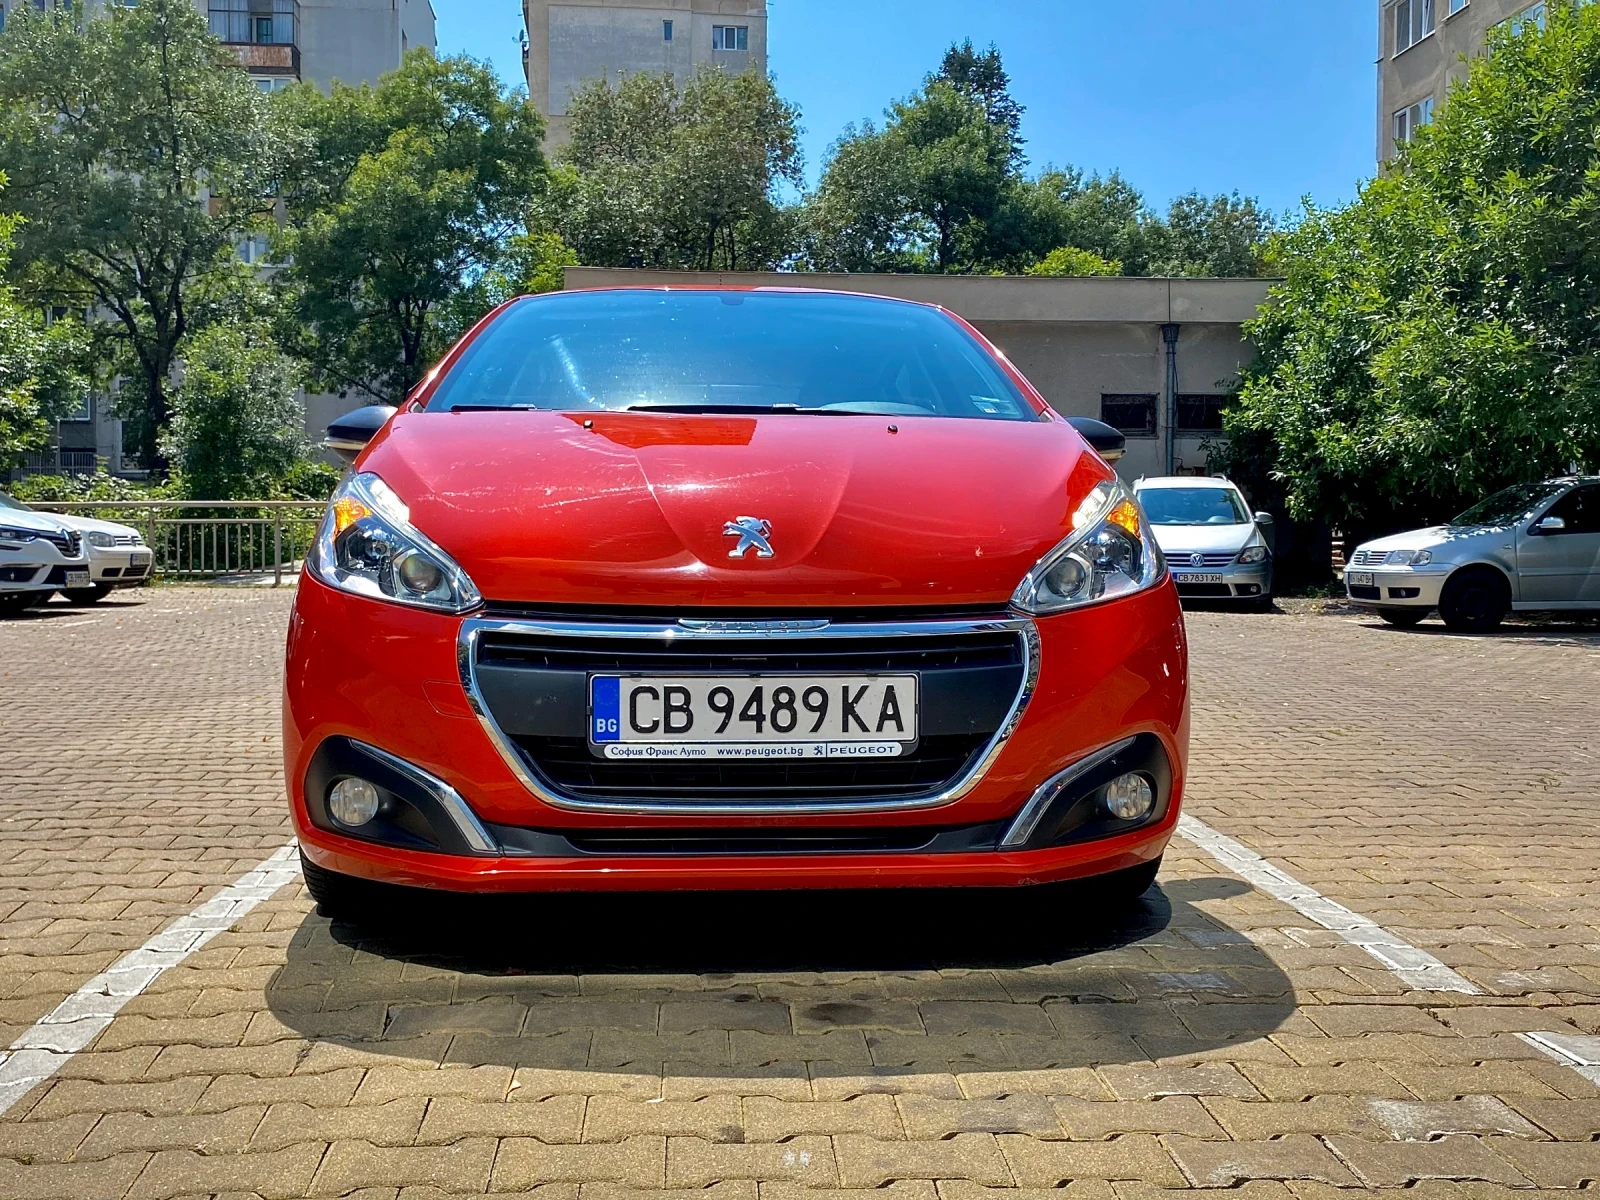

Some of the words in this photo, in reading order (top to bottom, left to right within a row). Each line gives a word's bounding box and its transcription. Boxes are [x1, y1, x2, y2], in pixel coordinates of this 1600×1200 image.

[1190, 574, 1208, 582] 7831
[629, 685, 694, 734] CB
[707, 685, 829, 734] 9489
[842, 684, 904, 733] KA
[596, 718, 617, 733] BG
[611, 746, 643, 757] София
[645, 746, 677, 757] Франс
[717, 746, 804, 757] www.peugeot.bg
[829, 746, 895, 754] PEUGEOT
